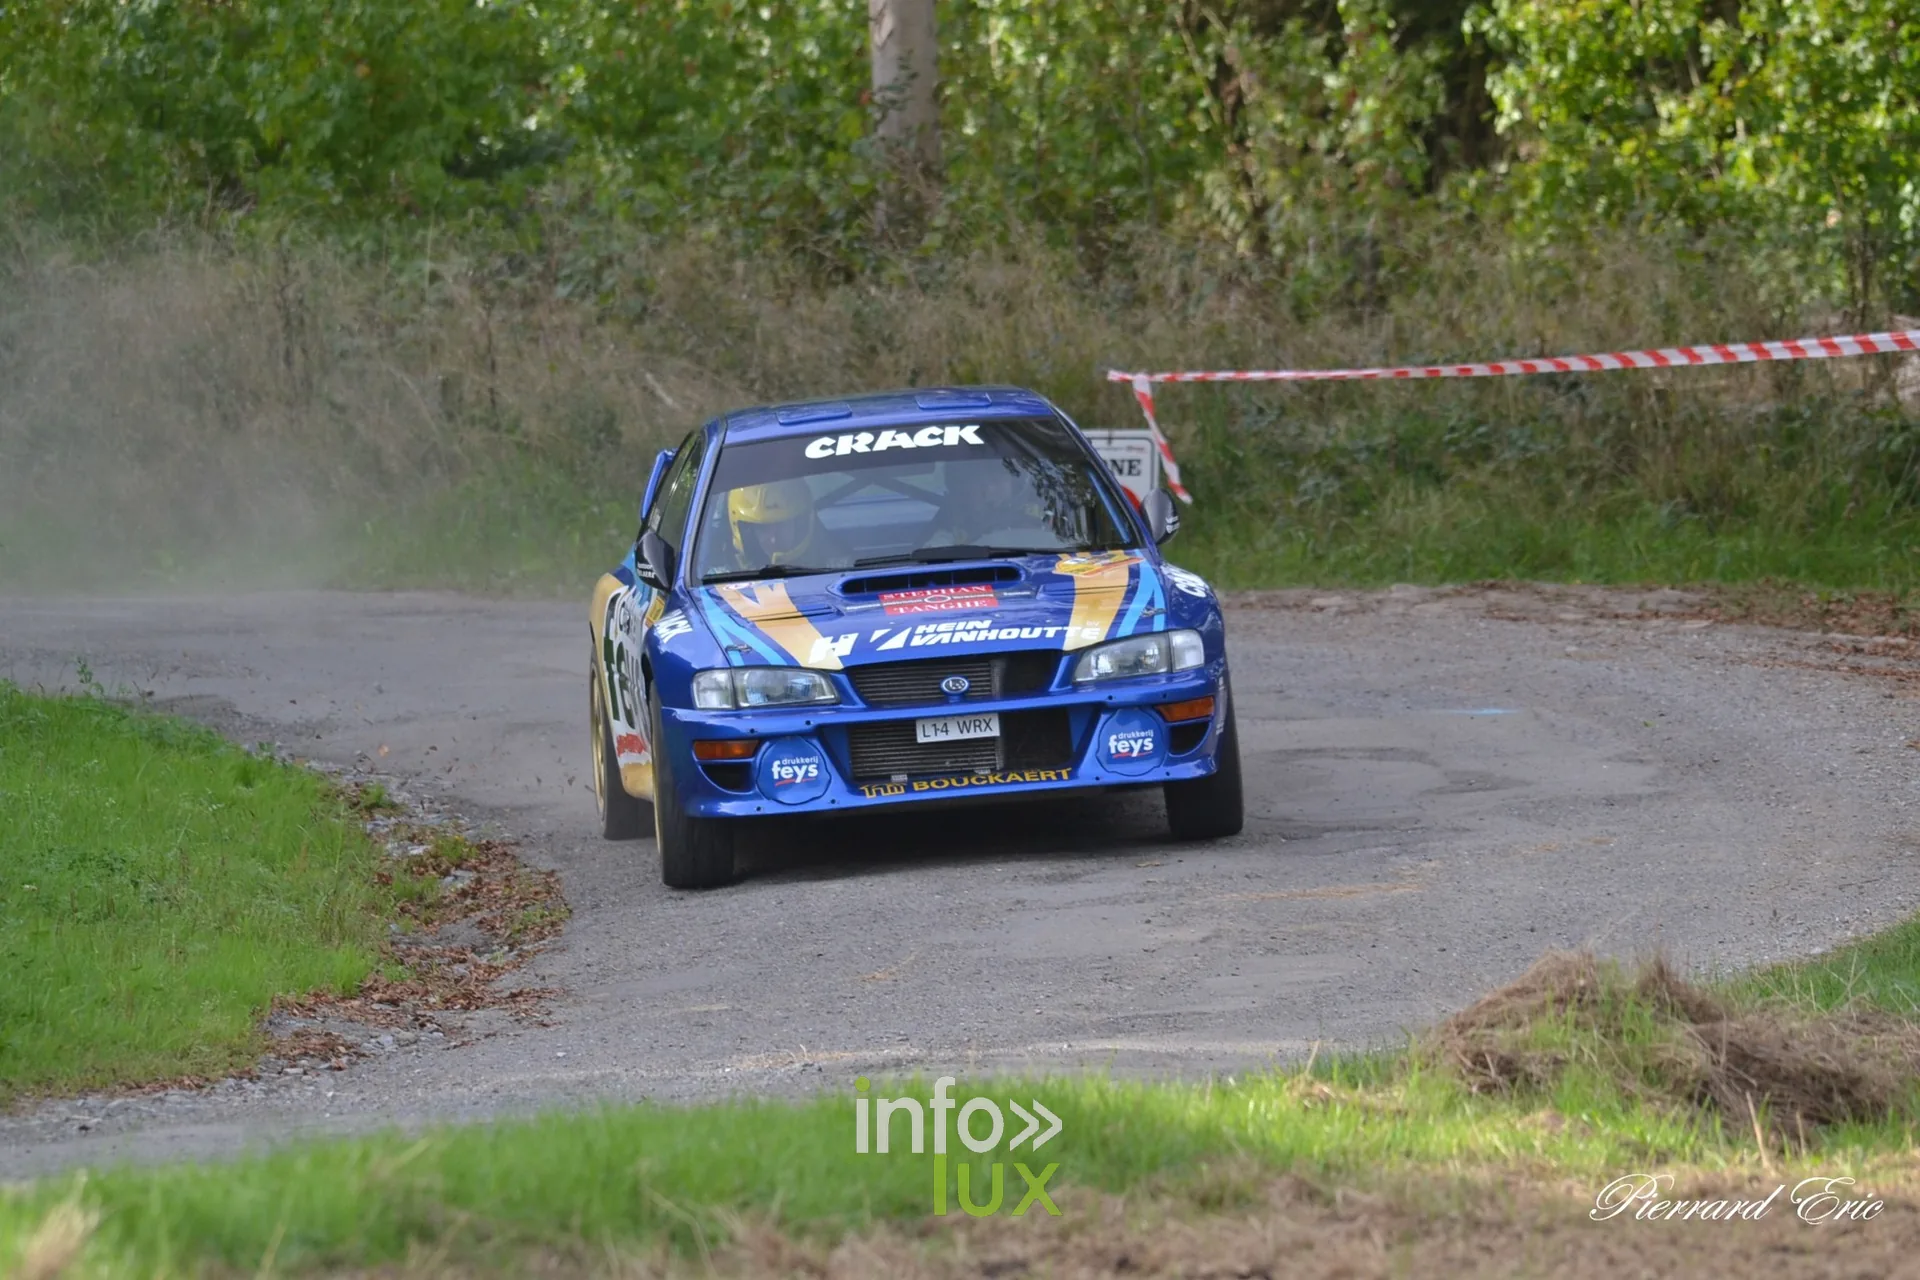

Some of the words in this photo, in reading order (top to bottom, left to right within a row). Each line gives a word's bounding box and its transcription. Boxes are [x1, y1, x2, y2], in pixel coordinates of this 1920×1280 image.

[805, 425, 984, 459] CRACK
[1104, 459, 1142, 476] NE
[883, 586, 986, 600] STEPHAN
[893, 599, 988, 614] TANGHE
[914, 620, 992, 634] HEIN
[910, 627, 1100, 647] VANHOUTTE
[921, 722, 950, 738] L14
[956, 718, 993, 735] WRX
[1118, 729, 1154, 739] drukkerij
[1108, 735, 1154, 757] feys
[781, 756, 818, 765] drukkerij
[771, 760, 818, 783] feys
[913, 768, 1072, 791] BOUCKAERT
